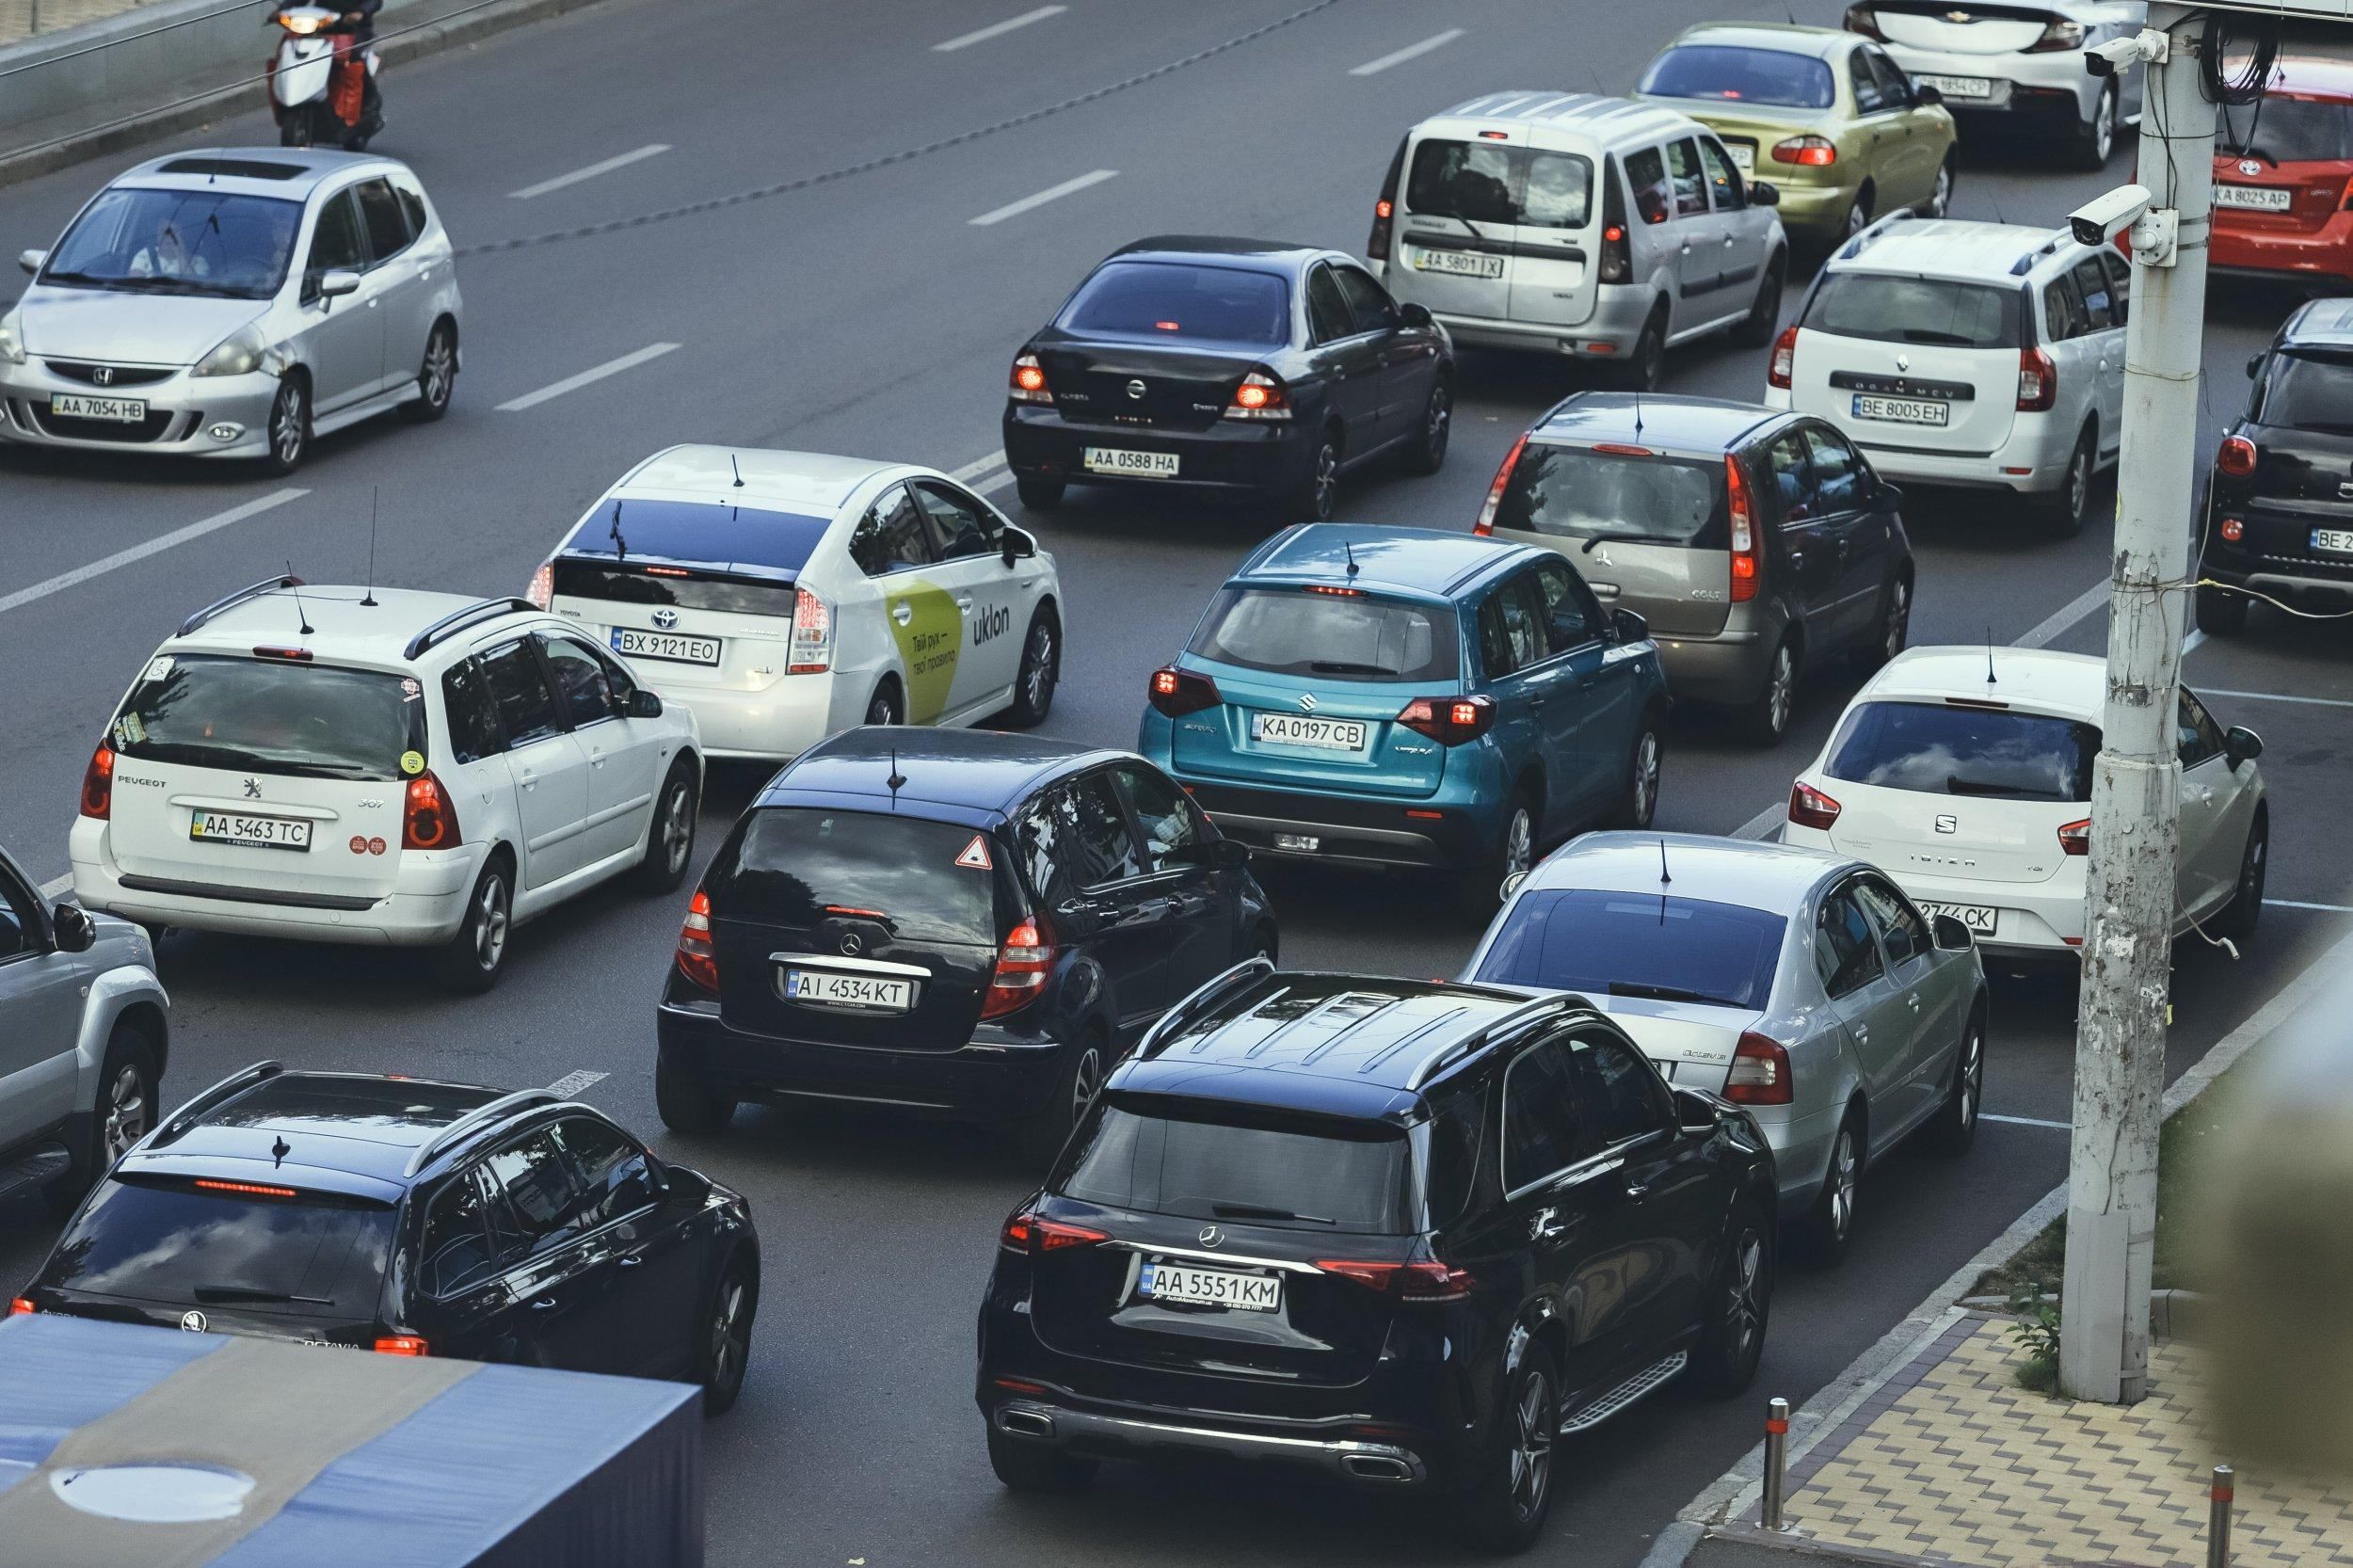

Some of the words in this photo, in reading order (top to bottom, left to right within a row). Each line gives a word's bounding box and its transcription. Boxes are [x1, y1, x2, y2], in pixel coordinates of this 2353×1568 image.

[2235, 192, 2265, 204] 8025
[2268, 194, 2287, 205] AP
[1425, 253, 1441, 267] AA
[1447, 256, 1477, 272] 5801
[1916, 388, 1954, 399] MCV
[62, 398, 81, 413] AA
[86, 400, 118, 416] 7054
[122, 403, 142, 418] HB
[1862, 399, 1882, 415] BE
[1886, 402, 1920, 419] 8005
[1923, 405, 1945, 421] EH
[1095, 450, 1113, 466] AA
[1118, 452, 1151, 469] 0588
[1155, 456, 1176, 472] HA
[2319, 532, 2341, 548] BE
[1691, 589, 1721, 600] COLT
[973, 603, 1010, 647] uklon
[622, 633, 646, 652] BX
[649, 637, 687, 657] 9121
[690, 642, 713, 660] EO
[912, 632, 927, 653] Твій
[928, 632, 940, 649] рух
[1262, 717, 1287, 736] KA
[1291, 720, 1330, 740] 0197
[1334, 725, 1360, 744] CB
[118, 775, 167, 788] PEUGEOT
[357, 798, 385, 808] 307
[203, 816, 228, 835] AA
[233, 819, 275, 840] 5463
[280, 823, 304, 842] TC
[232, 839, 264, 847] PEUGEOT
[1964, 908, 1991, 928] CK
[799, 976, 821, 996] AI
[829, 979, 872, 1000] 4534
[874, 983, 903, 1003] KT
[1153, 1270, 1183, 1293] AA
[1189, 1273, 1239, 1300] 5551
[1242, 1279, 1276, 1304] KM
